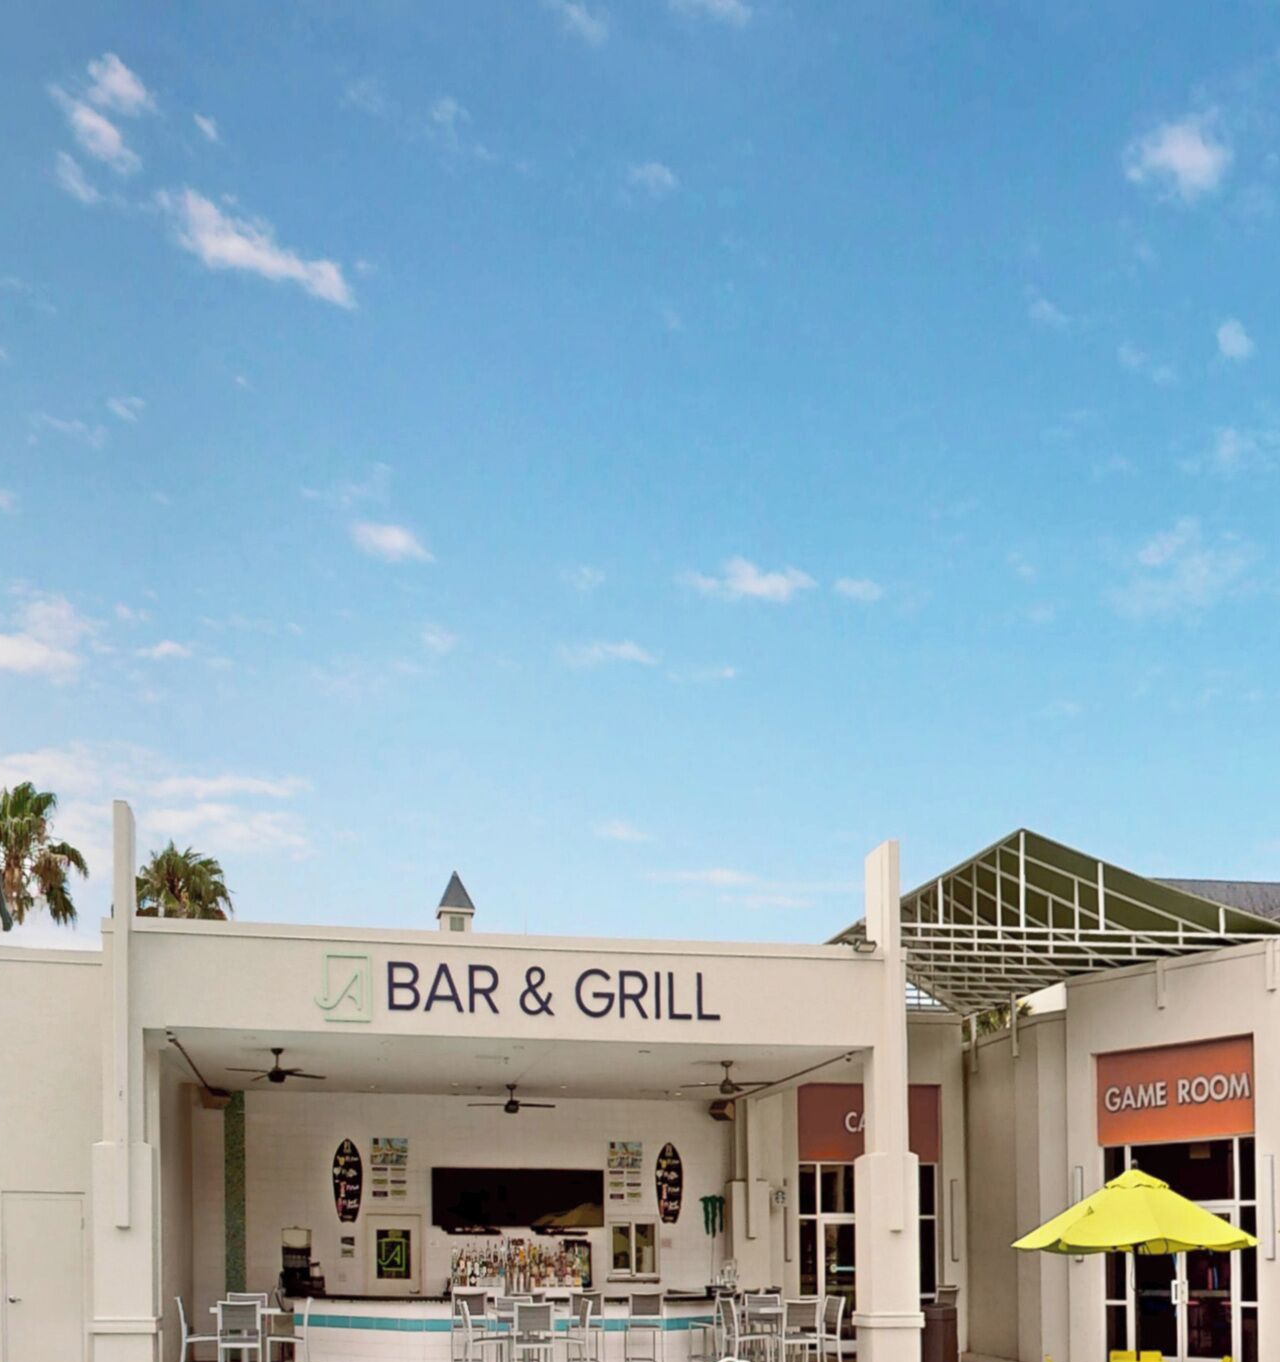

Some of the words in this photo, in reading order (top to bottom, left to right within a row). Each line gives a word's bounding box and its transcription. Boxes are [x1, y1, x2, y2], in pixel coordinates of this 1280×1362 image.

[386, 960, 500, 1014] BAR
[519, 965, 556, 1017] &
[574, 967, 721, 1021] GRILL
[1104, 1080, 1168, 1112] GAME
[1176, 1071, 1251, 1105] ROOM
